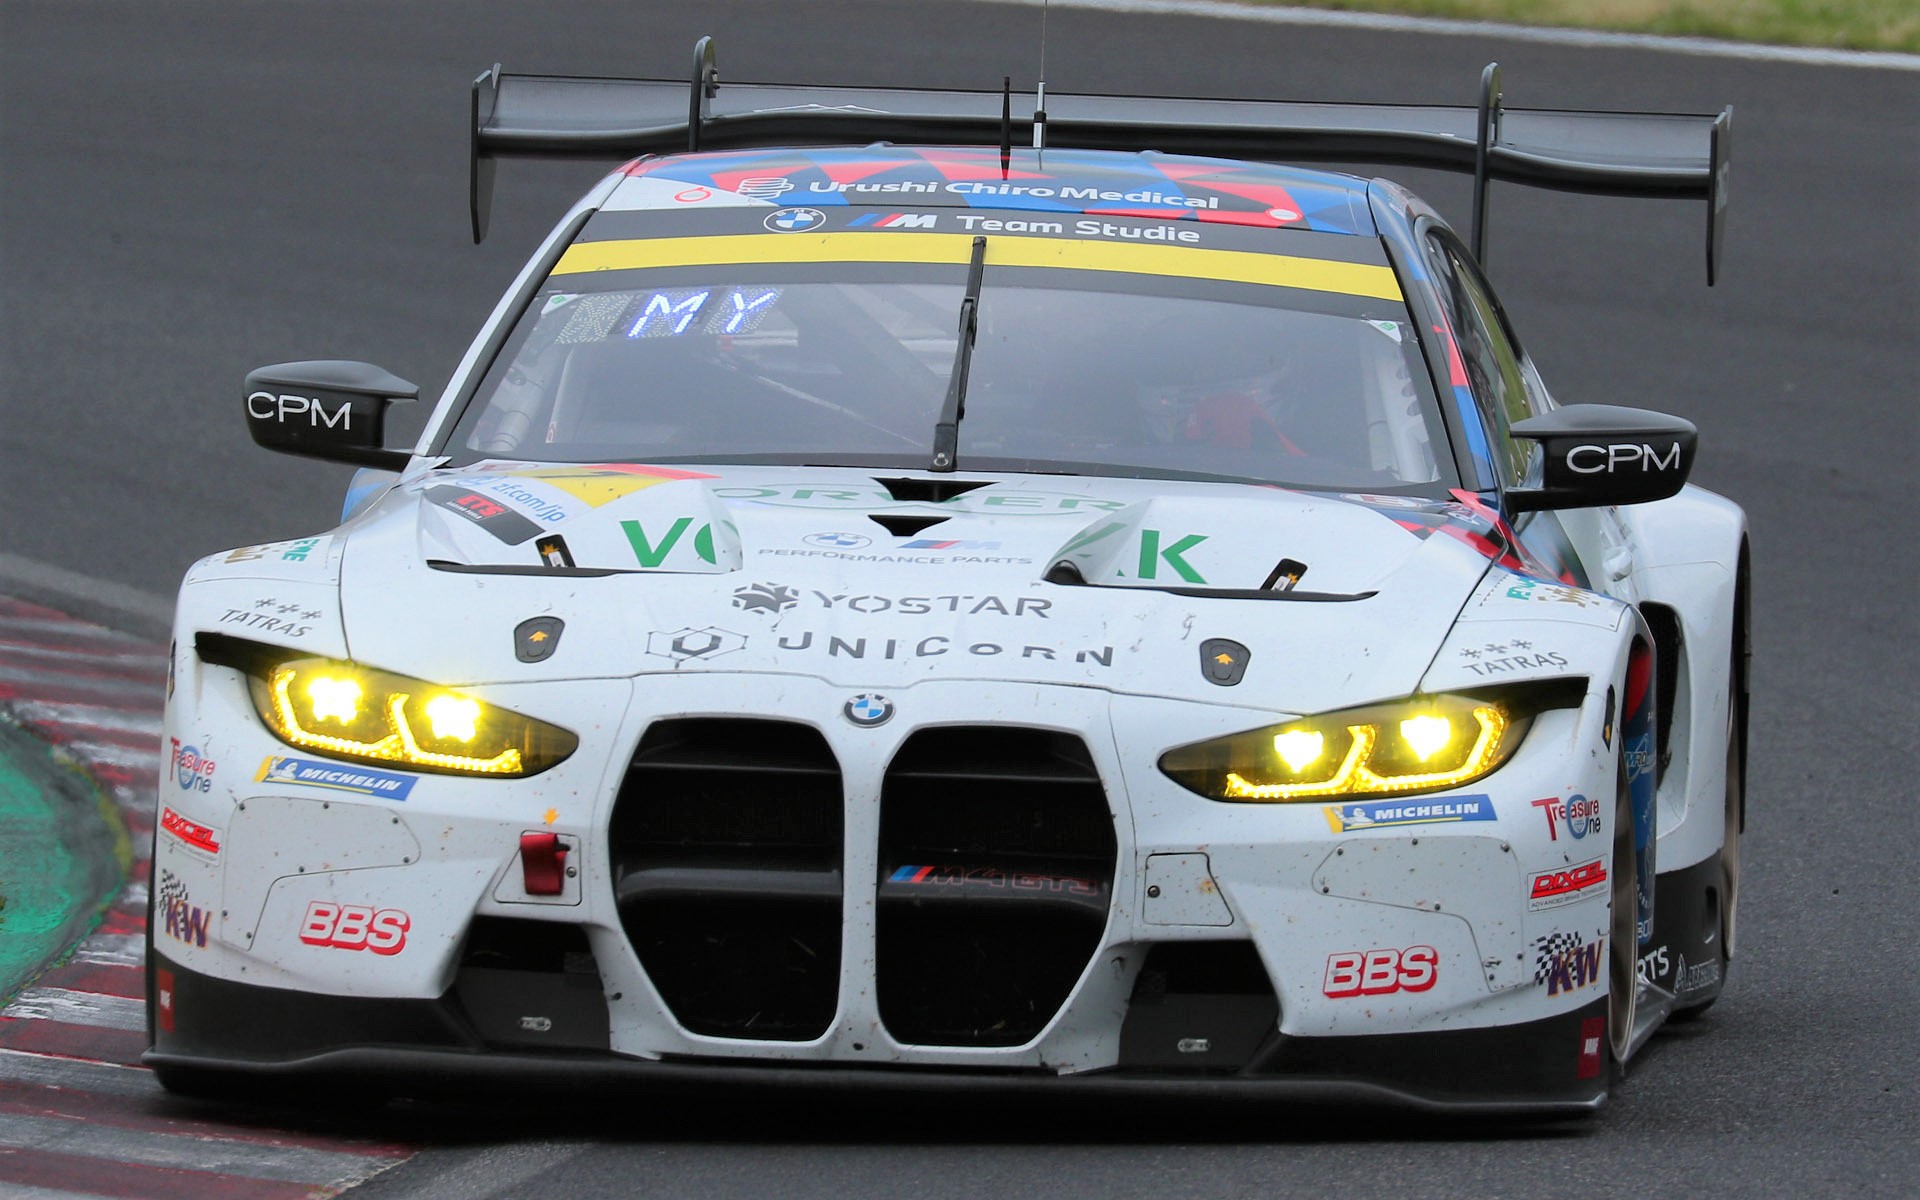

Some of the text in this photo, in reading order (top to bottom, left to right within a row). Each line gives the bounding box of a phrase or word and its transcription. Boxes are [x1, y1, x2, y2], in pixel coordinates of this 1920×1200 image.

[809, 181, 1219, 209] Urushi Chiro Medical
[956, 215, 1063, 234] Team
[1075, 219, 1200, 243] Studie
[247, 391, 352, 431] CPM
[1566, 441, 1681, 474] CPM
[491, 482, 567, 523] zf.com/jp
[758, 548, 1034, 565] PERFORMANCE PARTS
[811, 589, 1053, 619] YOSTAR
[219, 608, 313, 637] TATRAS
[1462, 651, 1569, 676] TATRAS
[299, 767, 402, 792] MICHELIN
[1374, 802, 1480, 820] MICHELIN
[1531, 796, 1600, 841] Treasure
[1530, 859, 1607, 900] DIXCEL
[164, 896, 214, 950] KW
[299, 899, 412, 956] BBS
[1321, 944, 1440, 999] BBS
[1547, 937, 1604, 997] KW
